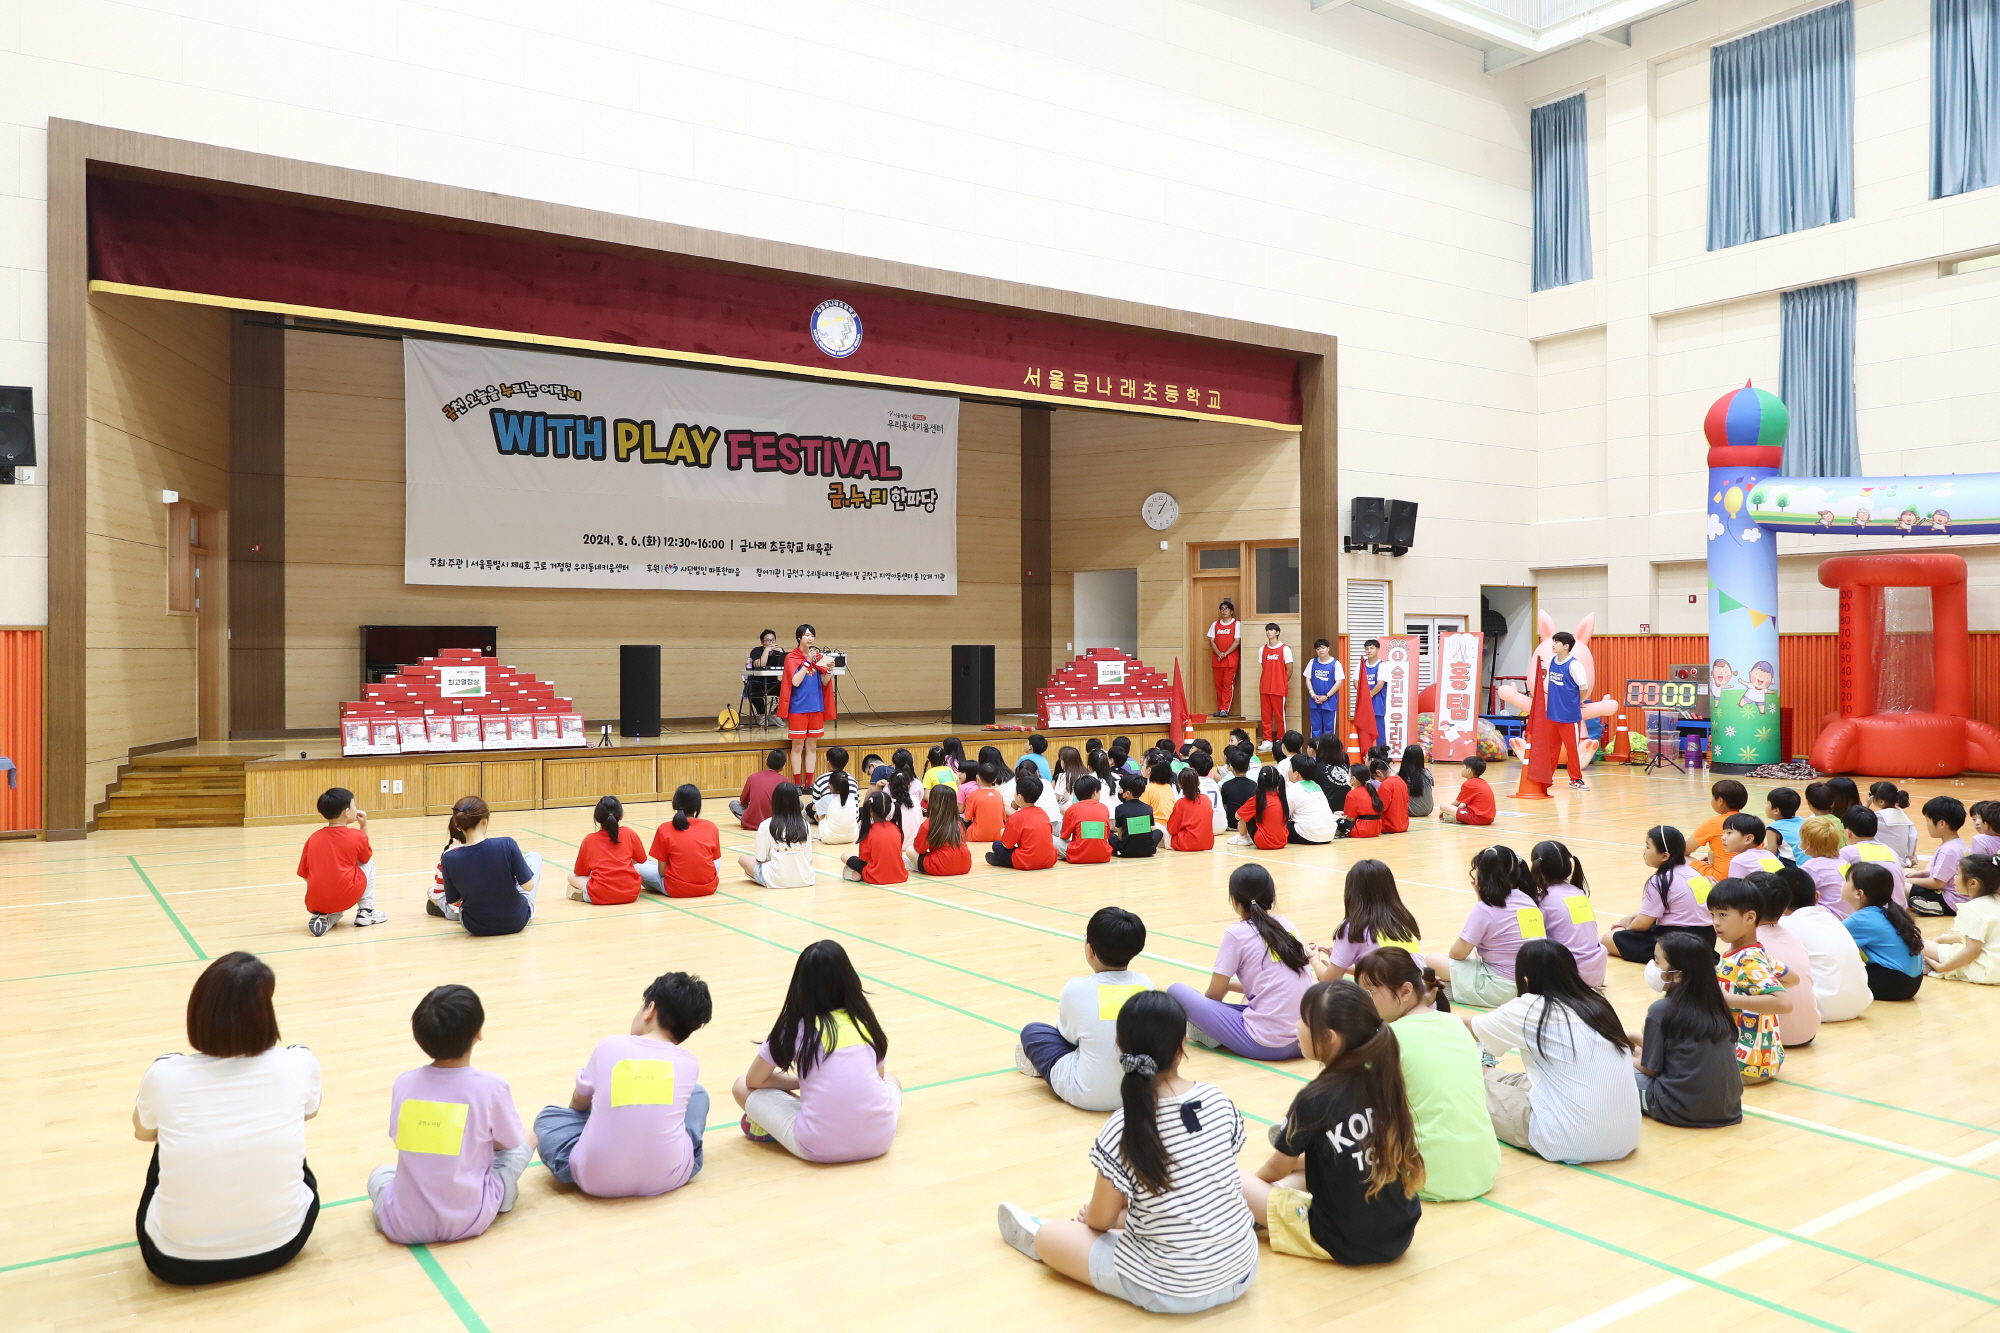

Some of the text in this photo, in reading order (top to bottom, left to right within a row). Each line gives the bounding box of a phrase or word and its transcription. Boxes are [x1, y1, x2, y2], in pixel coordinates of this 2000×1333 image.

[1023, 366, 1221, 410] 서울금나래초등학교
[442, 381, 582, 422] 금천 오늘을 누리는 어린이
[887, 419, 944, 434] 우리동네키움센터
[489, 408, 902, 481] WITH PLAY FESTIVAL
[890, 486, 938, 513] 한마당
[583, 534, 614, 546] 2024.
[617, 535, 628, 547] 8.
[663, 537, 725, 550] 12:30~16:00
[739, 539, 767, 553] 금나래
[769, 541, 804, 554] 초등학교
[806, 542, 833, 556] 체육관
[471, 559, 509, 571] 서울특별시
[511, 561, 531, 570] 제4호
[533, 561, 547, 570] 구로
[550, 562, 572, 572] 거점형
[574, 563, 629, 573] 우리동네키움센터
[646, 564, 660, 574] 후원
[680, 566, 741, 577] 사단법인 따뜻한마음
[756, 568, 781, 578] 참여기관
[786, 568, 805, 578] 금천구
[806, 570, 852, 580] 우리동네키움센터
[854, 571, 860, 580] 및
[879, 572, 913, 581] 지역아동센터
[934, 573, 945, 582] 기관
[1841, 629, 1851, 637] 70
[1841, 641, 1851, 650] 60
[1841, 654, 1851, 663] 50
[1841, 667, 1852, 675] 40
[448, 678, 480, 686] 최고열정상
[1841, 680, 1852, 688] 30
[1842, 692, 1852, 701] 20
[1388, 666, 1404, 755] 승리는 우리것
[1842, 705, 1852, 714] 10
